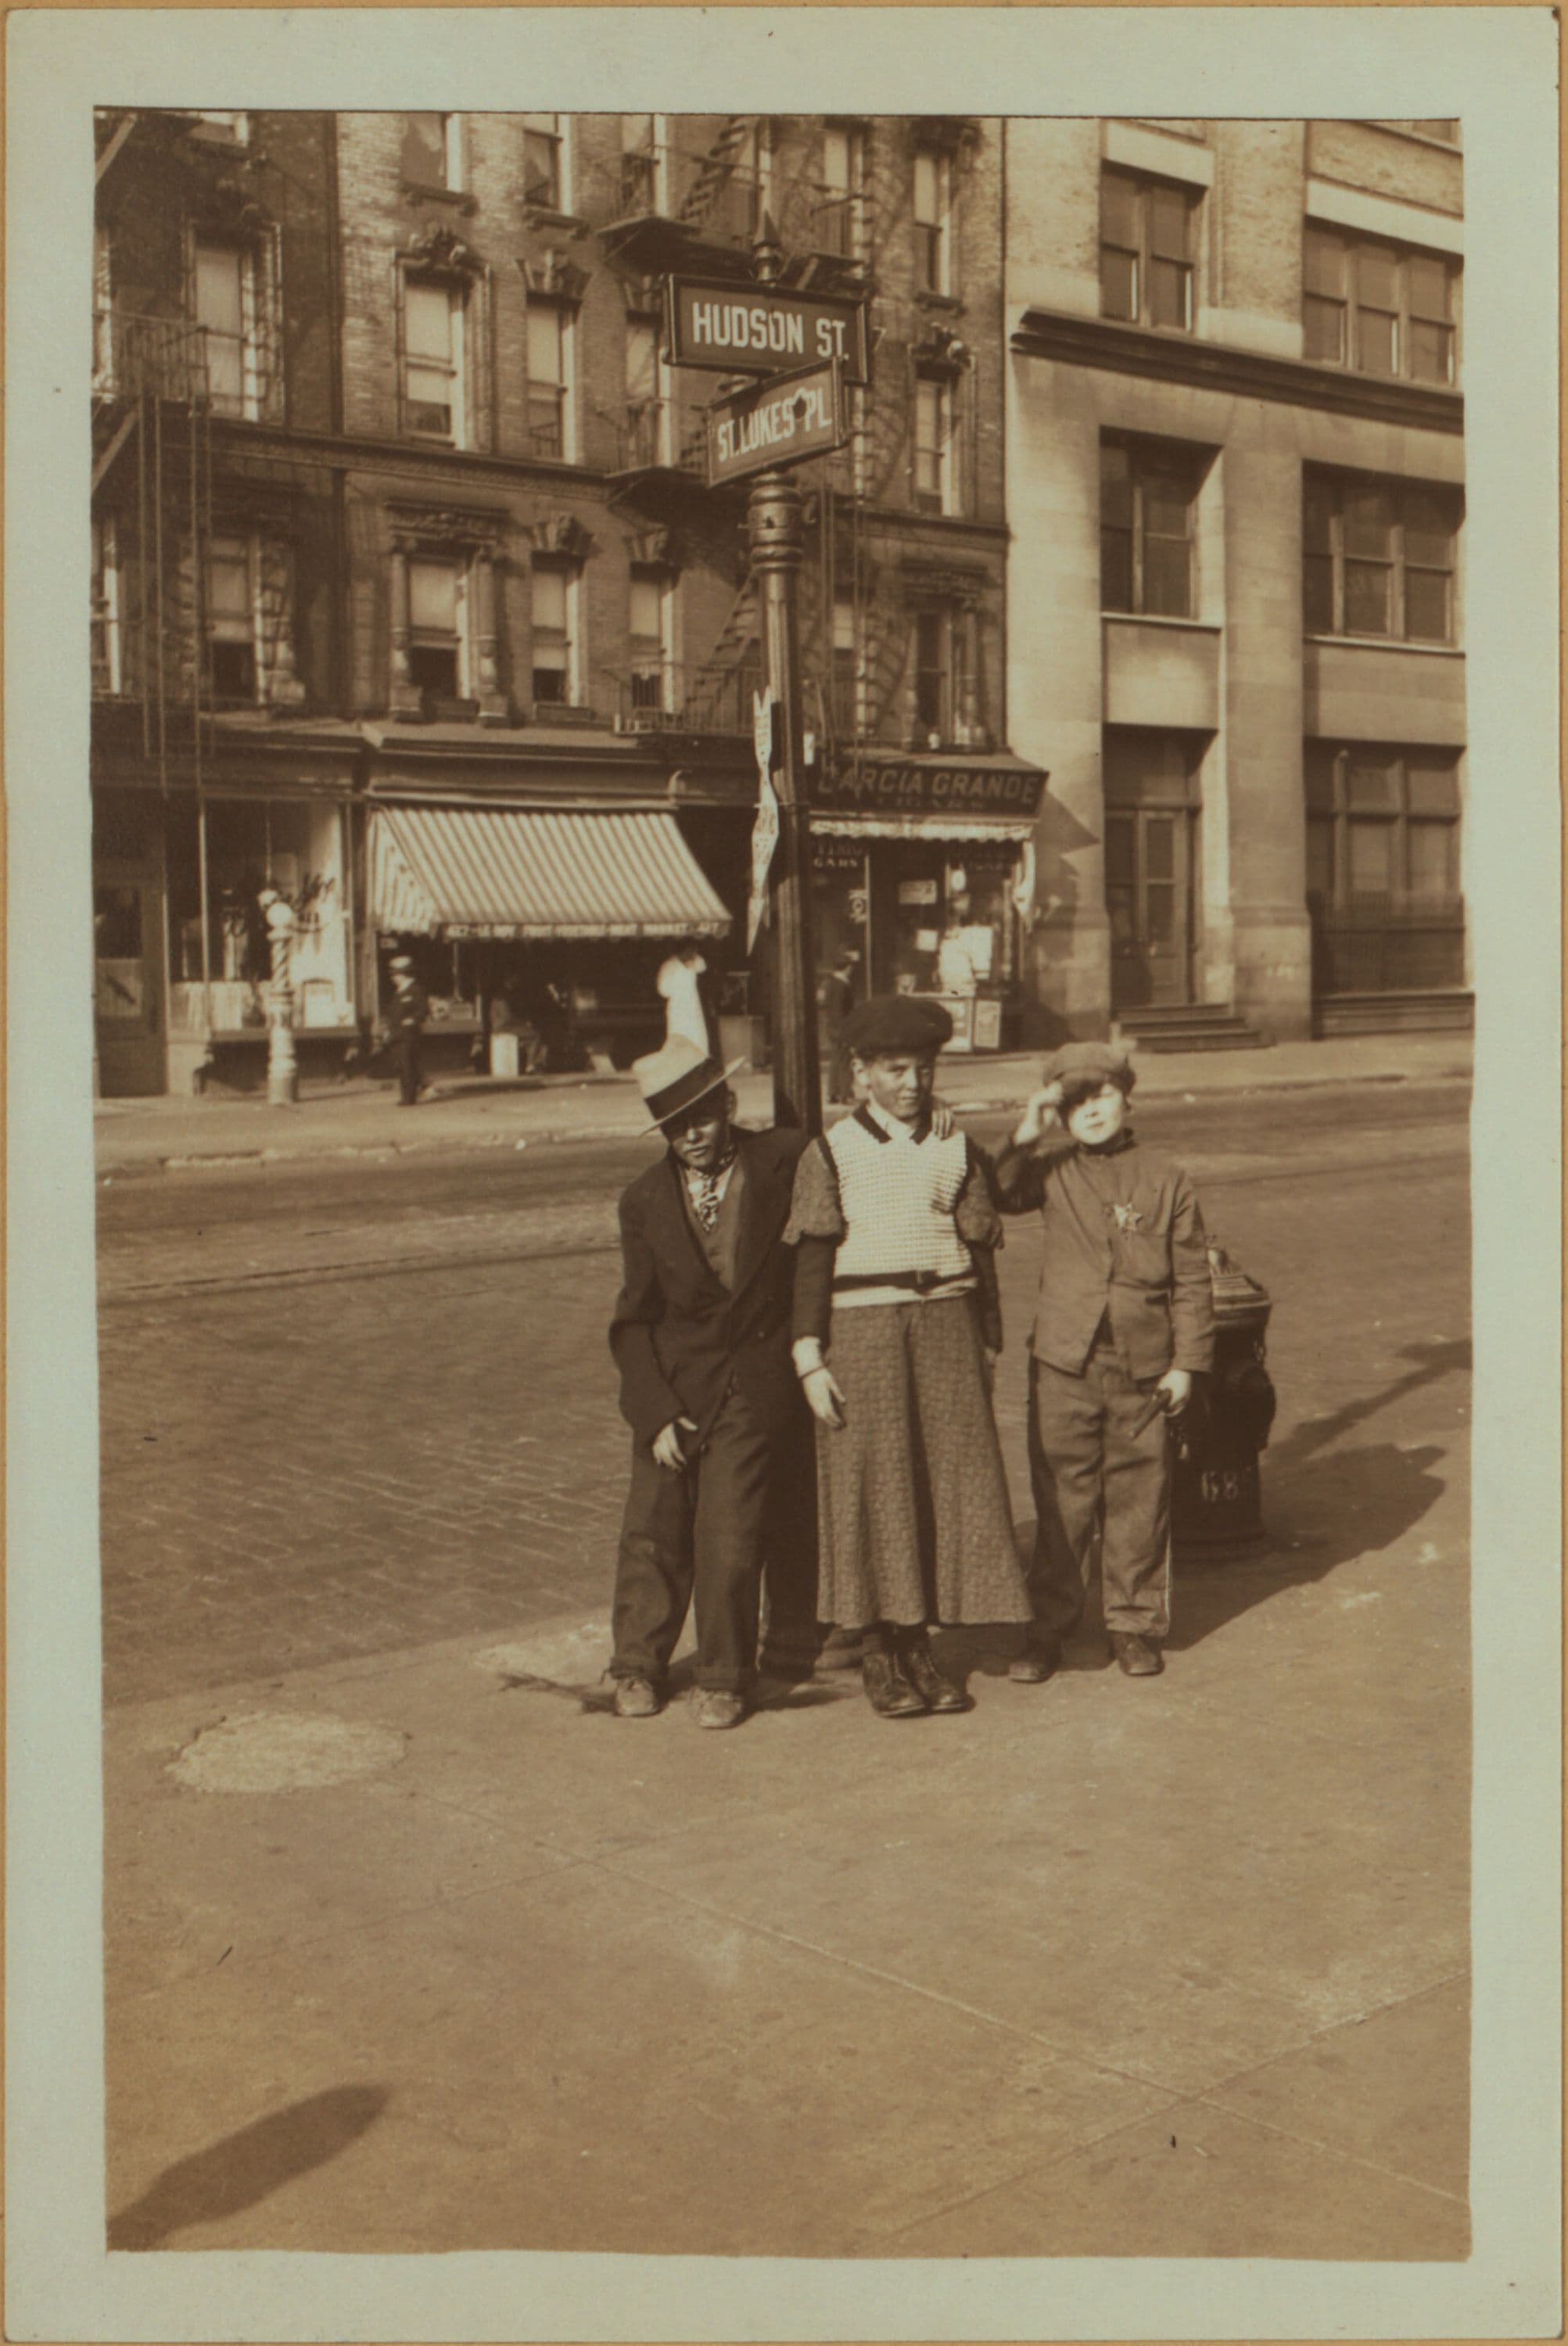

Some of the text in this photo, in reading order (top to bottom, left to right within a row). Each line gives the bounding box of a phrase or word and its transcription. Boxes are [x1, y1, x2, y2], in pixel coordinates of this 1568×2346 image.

[692, 301, 849, 361] HUDSON ST.
[931, 771, 1039, 805] GRANDE
